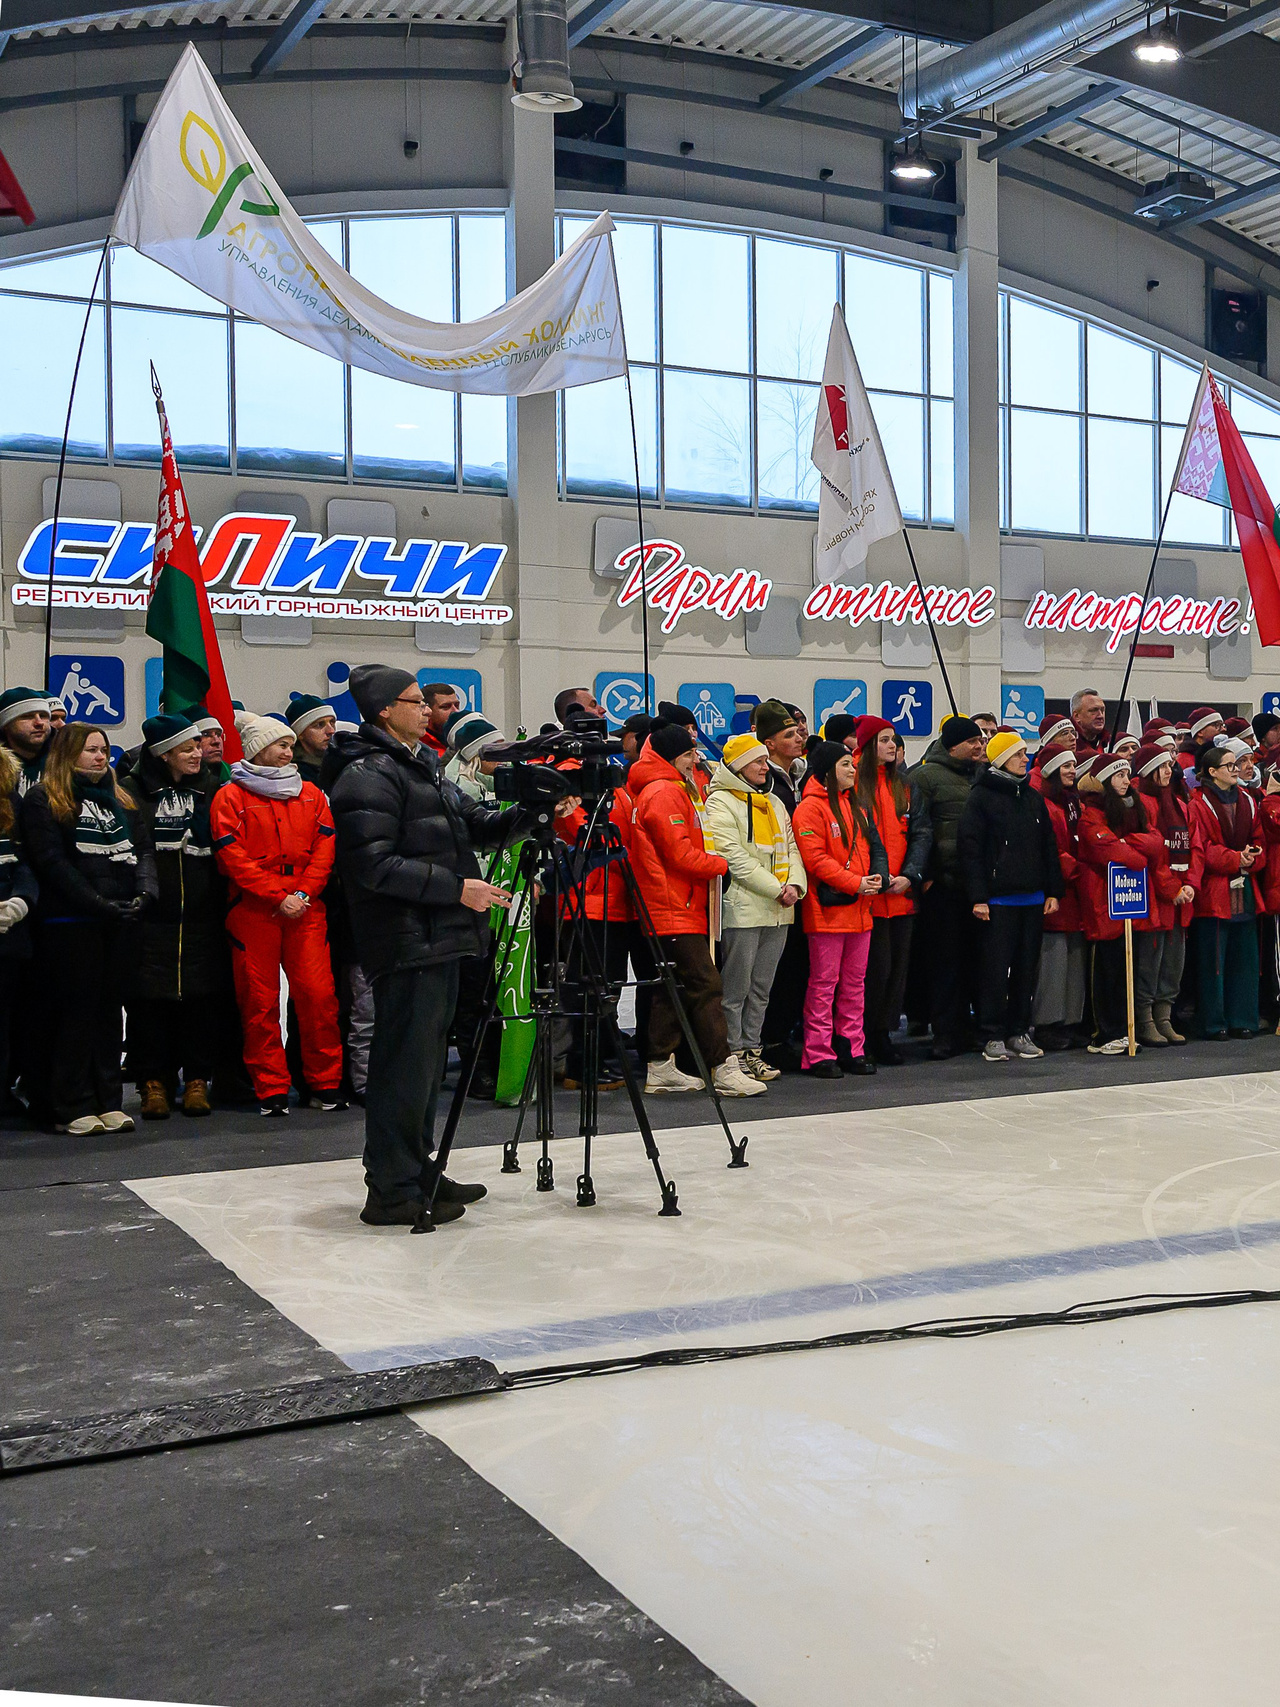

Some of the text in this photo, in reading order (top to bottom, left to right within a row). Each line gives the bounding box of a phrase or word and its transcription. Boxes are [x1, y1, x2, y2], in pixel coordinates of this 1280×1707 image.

[218, 239, 319, 310] УПРАВЛЕНИЯ
[556, 327, 612, 351] БЕЛАРУСЬ
[618, 541, 768, 630] Дарим
[806, 583, 995, 624] отличное
[16, 588, 509, 622] РЕСПУБЛИКИЙ ГОРНОЛЫЖНЫЙ ЦЕНТР
[629, 695, 652, 710] 24
